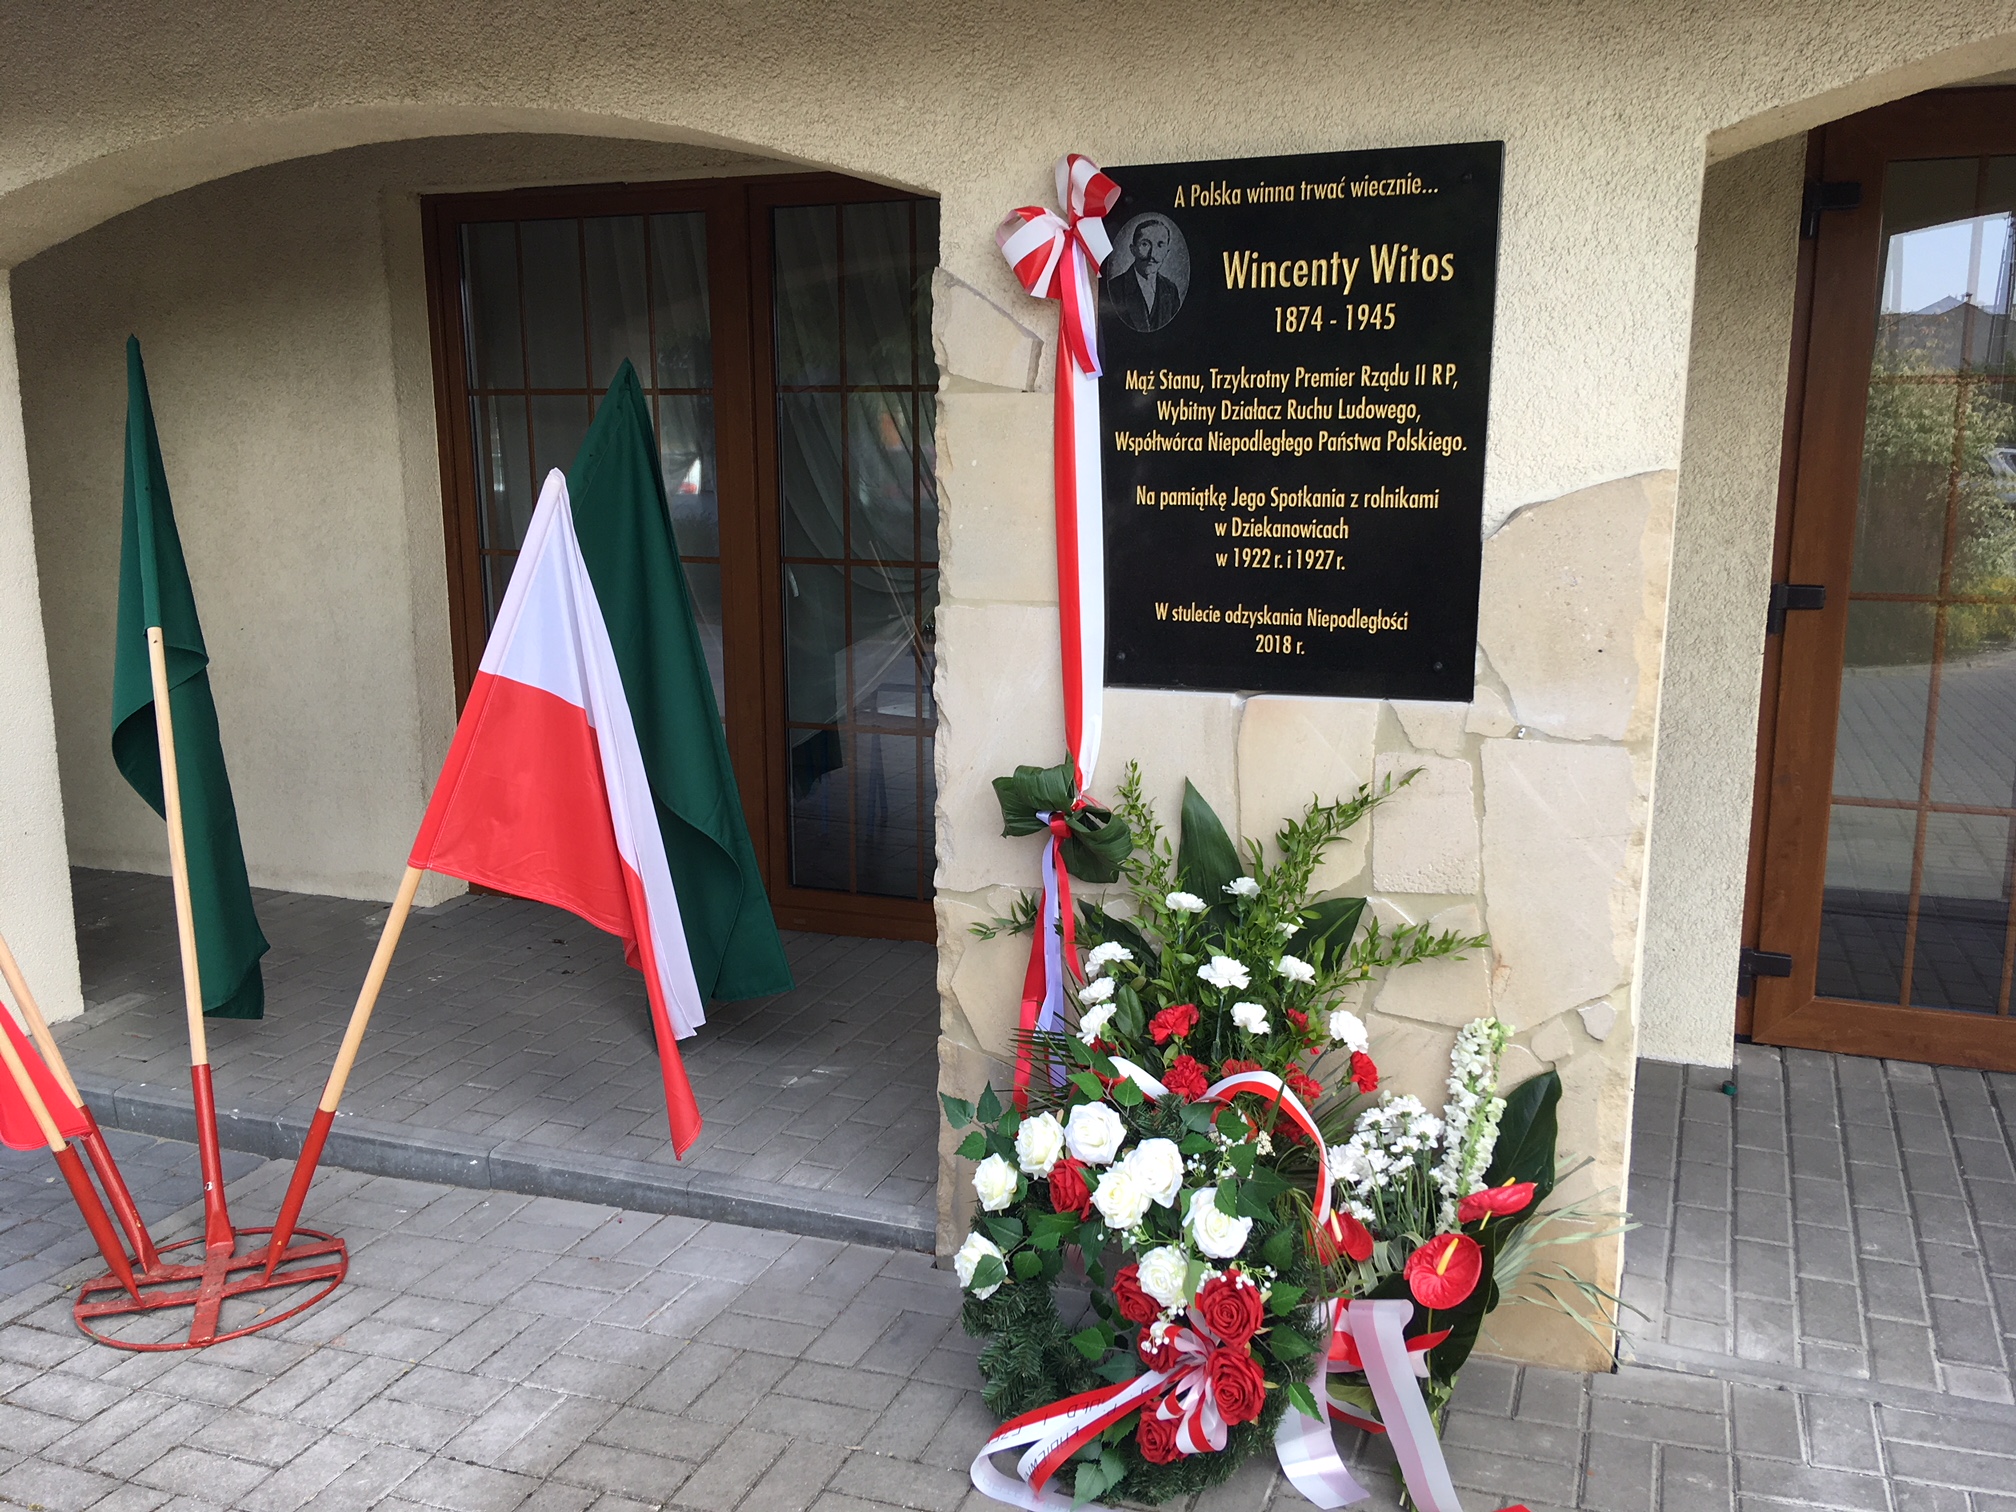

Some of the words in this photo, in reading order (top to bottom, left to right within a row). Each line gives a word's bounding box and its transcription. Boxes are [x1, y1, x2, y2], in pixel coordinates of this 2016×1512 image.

[1174, 185, 1186, 208] A
[1191, 181, 1241, 206] Polska
[1247, 184, 1294, 203] winna
[1301, 177, 1345, 200] trwać
[1351, 173, 1438, 197] wiecznie...
[1223, 251, 1359, 295] Wincenty
[1370, 244, 1454, 283] Witos
[1275, 306, 1323, 332] 1874
[1347, 303, 1395, 330] 1945
[1126, 370, 1155, 395] Mąż
[1160, 369, 1204, 393] Stanu,
[1210, 366, 1290, 393] Trzykrotny
[1295, 367, 1355, 387] Premier
[1361, 363, 1409, 391] Rządu
[1414, 363, 1427, 386] II
[1432, 364, 1457, 389] RP,
[1157, 399, 1215, 425] Wybitny
[1222, 398, 1282, 420] Działacz
[1288, 397, 1332, 419] Ruchu
[1339, 397, 1420, 424] Ludowego,
[1115, 430, 1202, 456] Współtwórca
[1208, 429, 1312, 456] Niepodległego
[1319, 431, 1381, 451] Państwa
[1387, 428, 1467, 456] Polskiego.
[1136, 484, 1156, 506] Na
[1160, 485, 1226, 511] pamiątkę
[1231, 487, 1265, 511] Jego
[1271, 486, 1345, 509] Spotkania
[1349, 493, 1360, 508] z
[1364, 486, 1439, 508] rolnikami
[1214, 522, 1228, 537] w
[1232, 516, 1348, 538] Dziekanowicach
[1215, 552, 1229, 567] w
[1234, 548, 1271, 568] 1922
[1297, 549, 1334, 569] 1927
[1154, 601, 1169, 621] W
[1172, 602, 1220, 622] stulecie
[1225, 607, 1302, 628] odzyskania
[1307, 608, 1408, 634] Niepodległości
[1256, 634, 1291, 653] 2018
